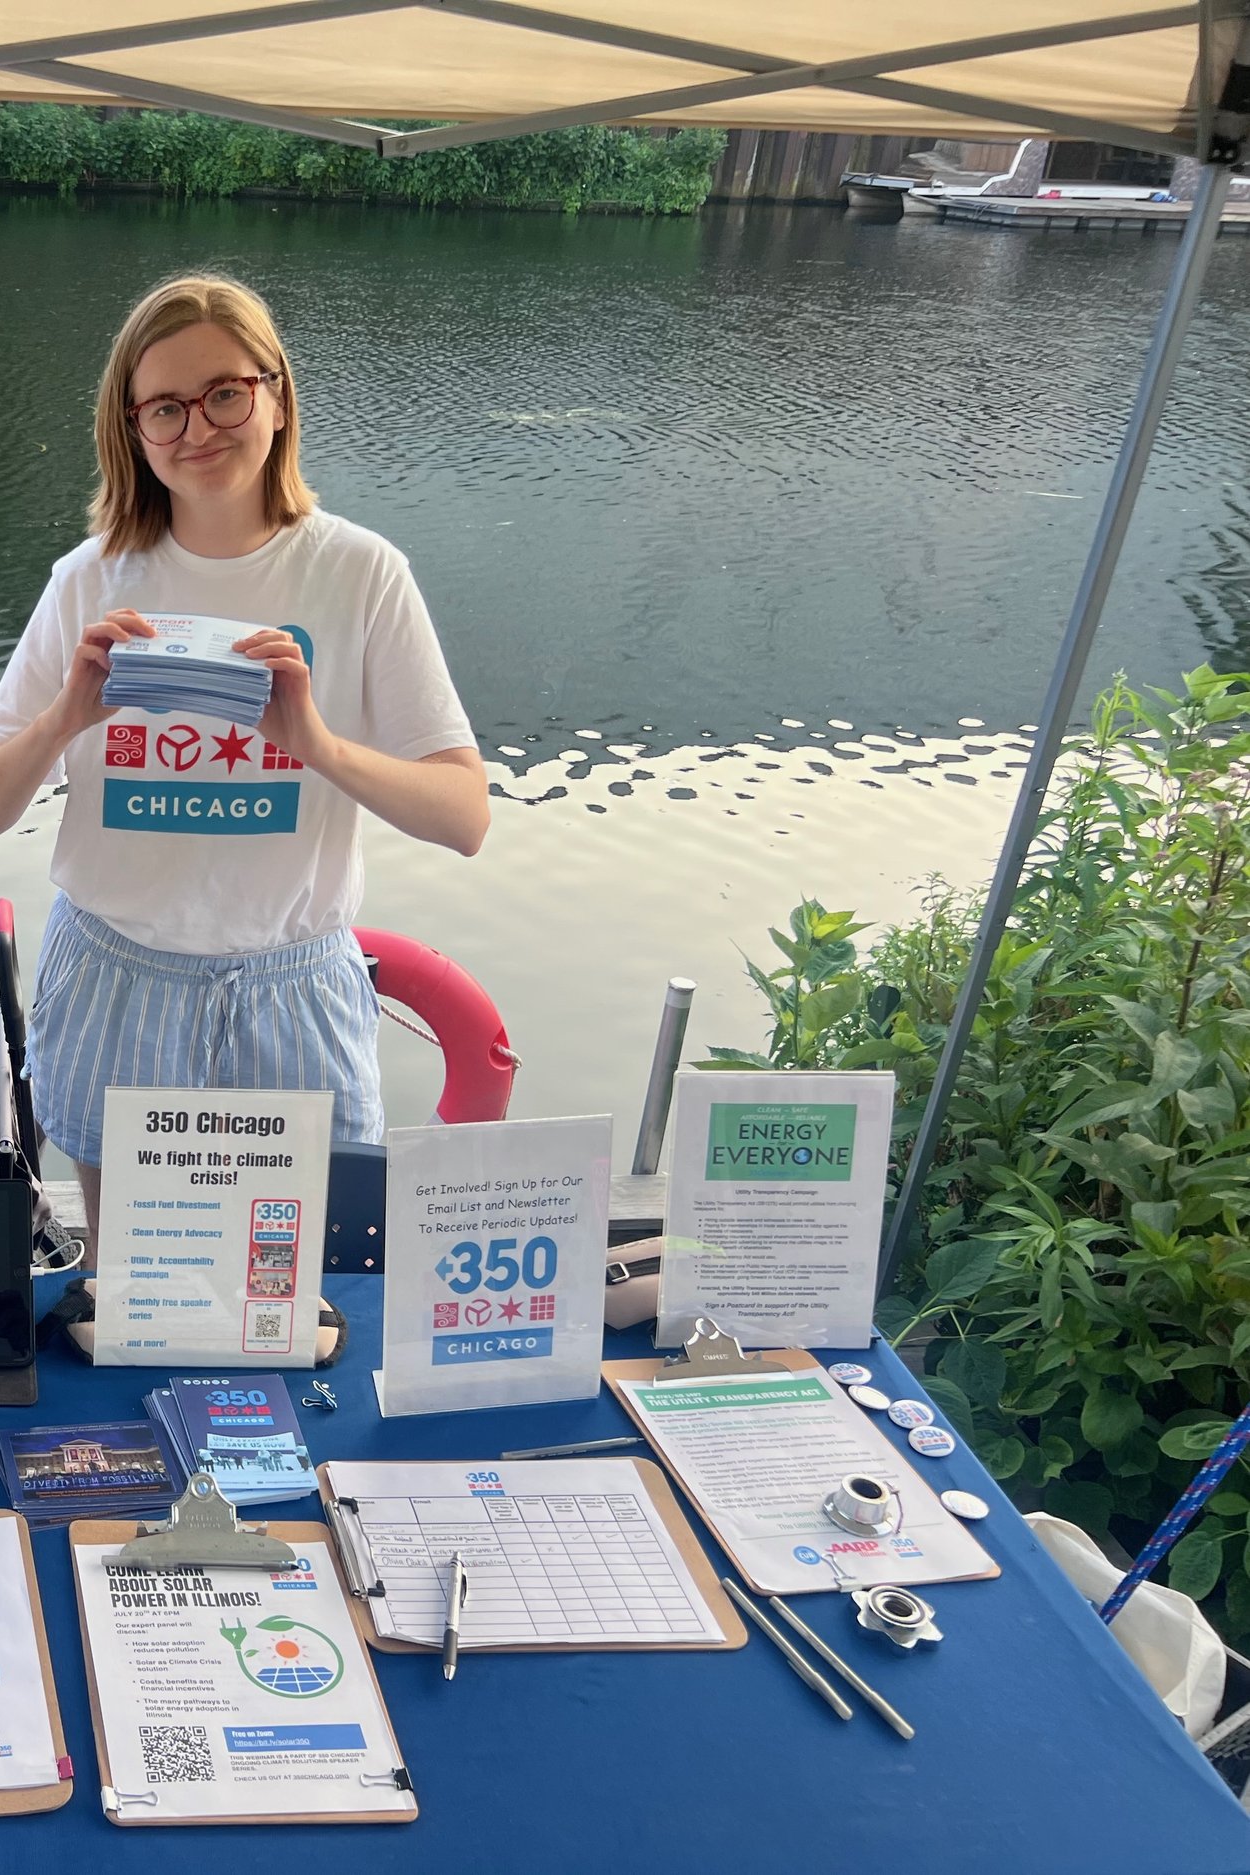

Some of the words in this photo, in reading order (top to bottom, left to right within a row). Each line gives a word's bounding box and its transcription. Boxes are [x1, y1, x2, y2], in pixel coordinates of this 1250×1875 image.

[127, 796, 272, 818] CHICAGO
[146, 1111, 188, 1133] 350
[197, 1112, 285, 1136] Chicago
[739, 1124, 827, 1140] ENERGY
[138, 1151, 161, 1166] We
[167, 1151, 201, 1167] fight
[208, 1152, 231, 1167] the
[237, 1153, 293, 1168] climate
[712, 1147, 849, 1166] EVERYONE
[191, 1171, 238, 1185] crisis!
[416, 1185, 436, 1196] Get
[440, 1180, 491, 1195] Involved!
[494, 1180, 518, 1192] Sign
[522, 1179, 537, 1191] Up
[541, 1177, 558, 1188] for
[562, 1176, 583, 1187] Our
[133, 1201, 156, 1209] Fossil
[158, 1201, 174, 1209] Fuel
[177, 1201, 221, 1210] Divestment
[260, 1204, 296, 1220] 350
[427, 1203, 457, 1215] Email
[460, 1201, 481, 1212] List
[485, 1200, 504, 1211] and
[508, 1196, 571, 1208] Newsletter
[419, 1224, 432, 1234] To
[436, 1221, 478, 1233] Receive
[482, 1217, 525, 1230] Periodic
[530, 1214, 578, 1228] Updates!
[132, 1229, 154, 1237] Clean
[156, 1229, 183, 1238] Energy
[185, 1229, 222, 1238] Advocacy
[131, 1256, 153, 1266] Utility
[158, 1257, 214, 1266] Accountability
[448, 1235, 558, 1294] 350
[130, 1270, 169, 1280] Campaign
[129, 1298, 160, 1307] Monthly
[162, 1298, 178, 1307] free
[181, 1299, 212, 1308] speaker
[128, 1311, 152, 1320] series
[127, 1339, 142, 1347] and
[144, 1339, 167, 1348] more!
[448, 1337, 537, 1355] CHICAGO
[210, 1390, 267, 1406] 350
[649, 1398, 670, 1407] THE
[671, 1396, 710, 1406] UTILITY
[713, 1391, 798, 1403] TRANSPARENCY
[801, 1389, 821, 1397] ACT
[468, 1472, 500, 1483] 350
[832, 1541, 879, 1553] AARP
[109, 1578, 157, 1592] ABOUT
[163, 1578, 213, 1591] SOLAR
[111, 1594, 168, 1608] POWER
[169, 1594, 188, 1607] IN
[192, 1592, 262, 1607] ILLINOIS!
